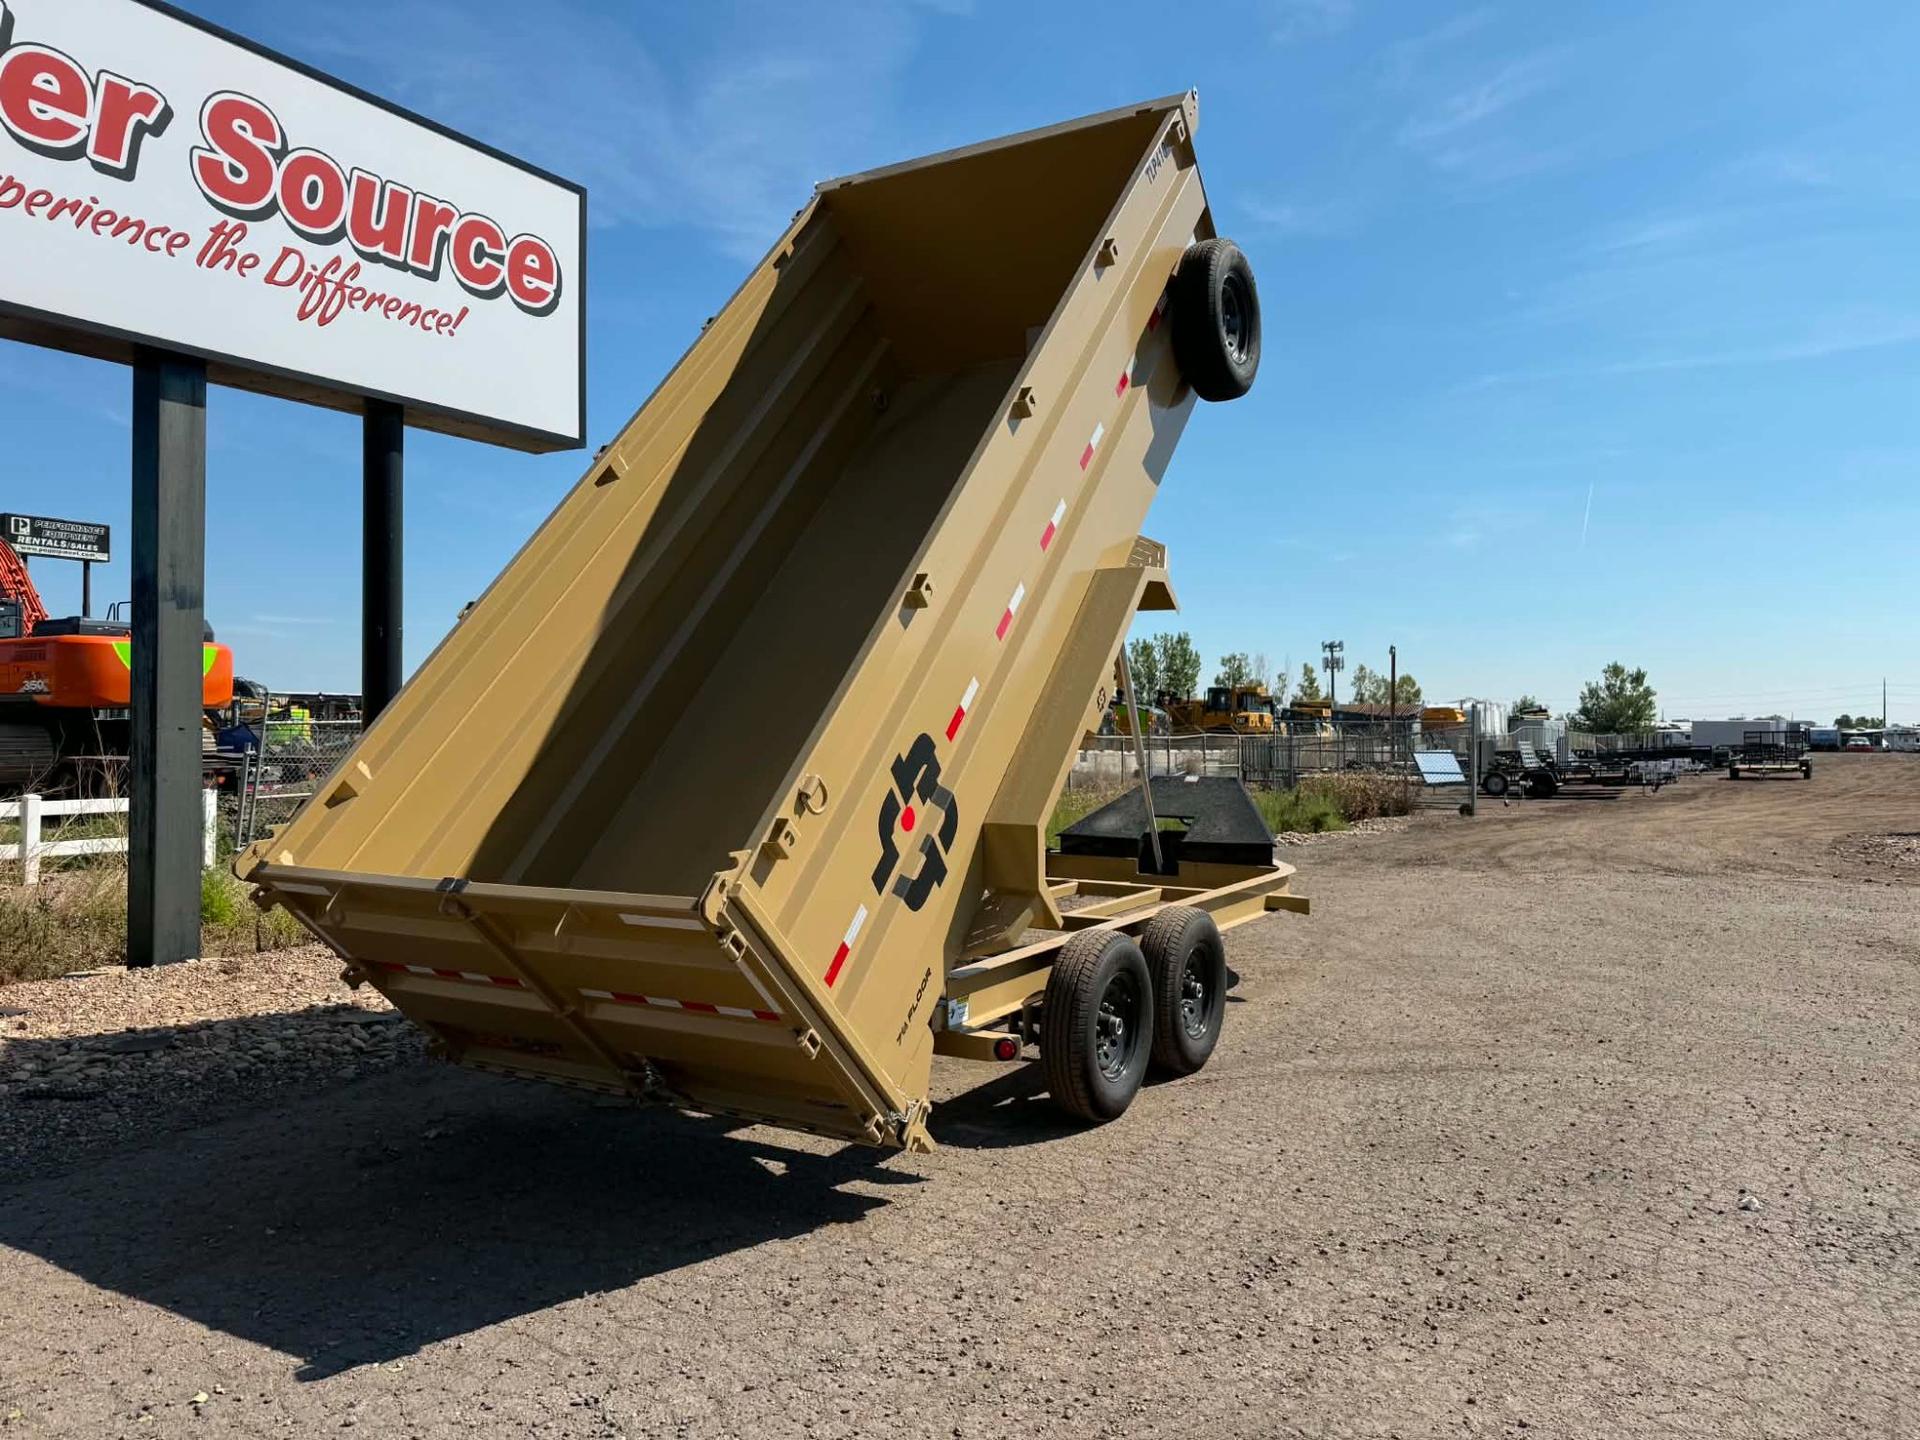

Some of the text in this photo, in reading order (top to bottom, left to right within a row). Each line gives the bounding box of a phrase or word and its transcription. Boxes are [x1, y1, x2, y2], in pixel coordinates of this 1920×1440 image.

[0, 0, 562, 317] er Source
[0, 174, 469, 337] perience the Difference!
[35, 520, 105, 534] PERFORMANCE
[907, 967, 932, 1023] FLOOR
